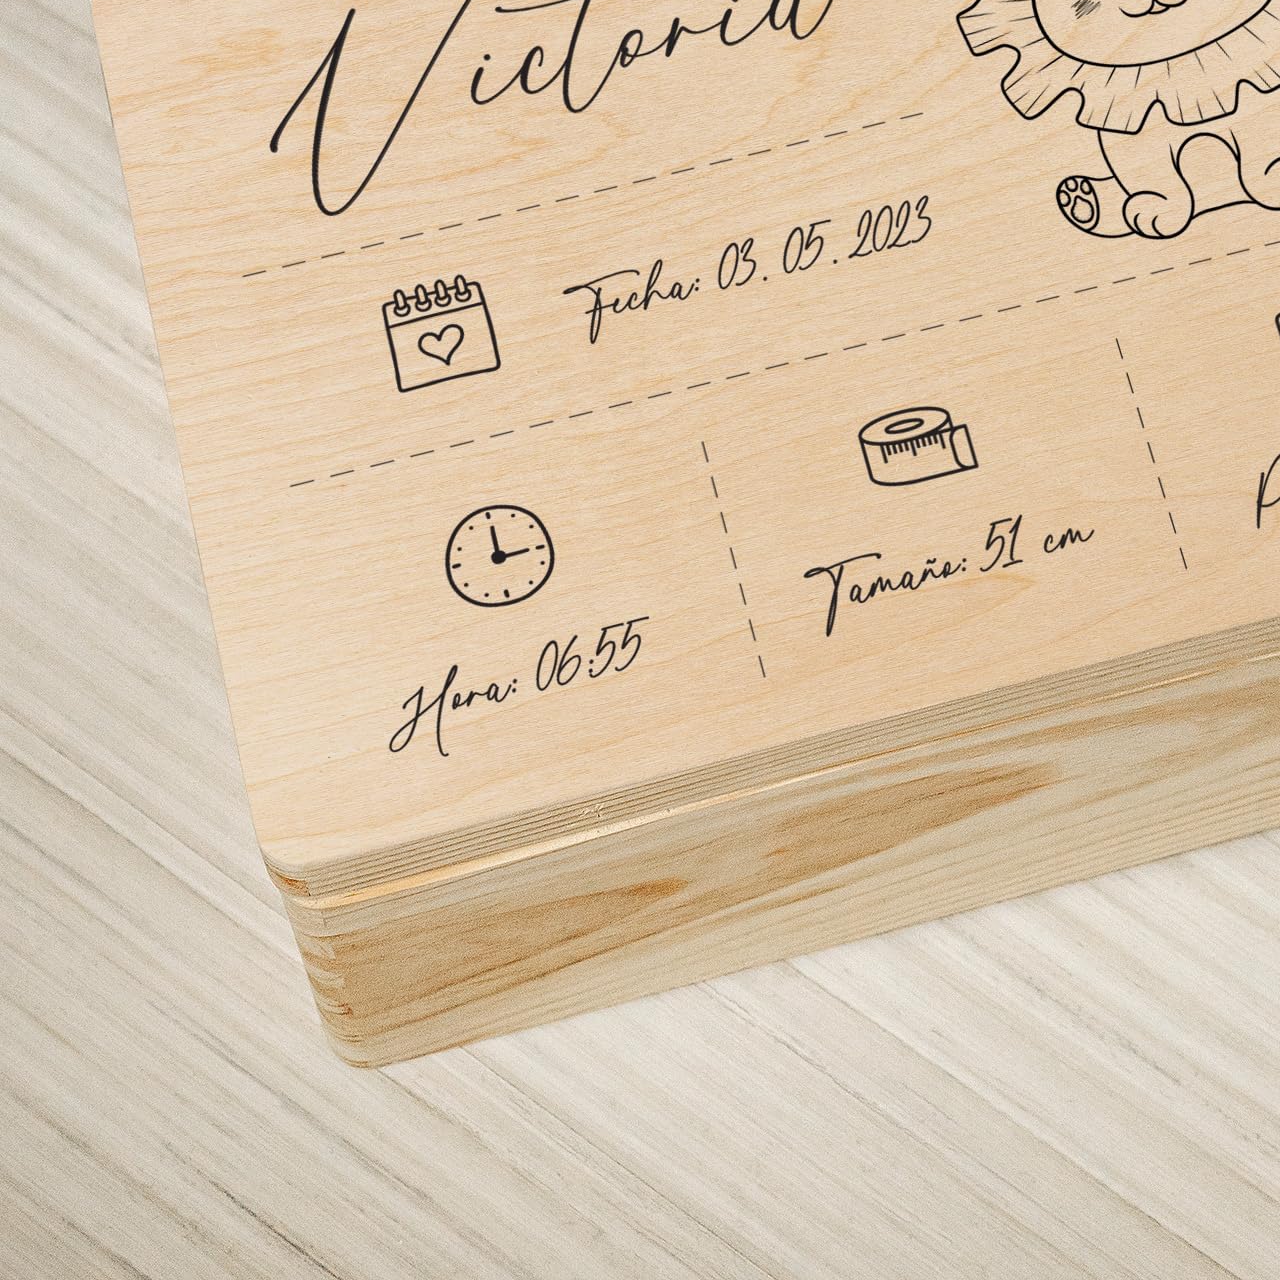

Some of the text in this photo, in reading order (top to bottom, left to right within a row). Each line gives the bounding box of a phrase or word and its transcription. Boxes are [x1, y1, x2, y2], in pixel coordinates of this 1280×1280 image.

[563, 259, 701, 345] Fecha:
[803, 514, 1095, 638] Tamaño: 51 cm
[389, 616, 650, 757] Hora: 06:55
